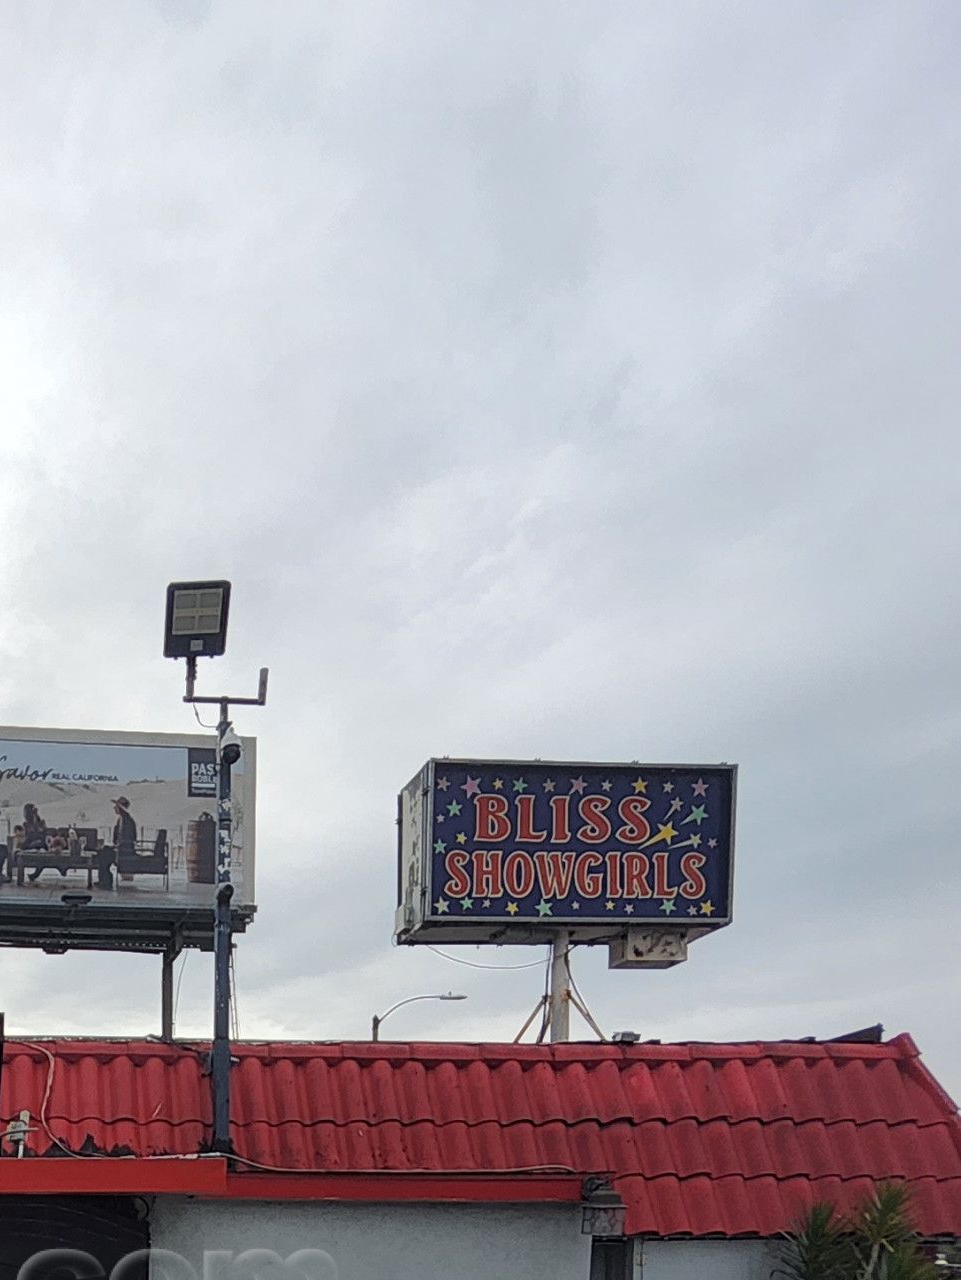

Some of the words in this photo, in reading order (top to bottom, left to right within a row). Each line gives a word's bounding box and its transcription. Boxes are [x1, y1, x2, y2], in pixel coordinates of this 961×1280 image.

[51, 773, 70, 781] REAL
[72, 773, 118, 782] CALIFORNIA
[191, 763, 216, 775] PAS
[474, 794, 651, 844] BLISS
[444, 850, 706, 899] SHOWGIRLS
